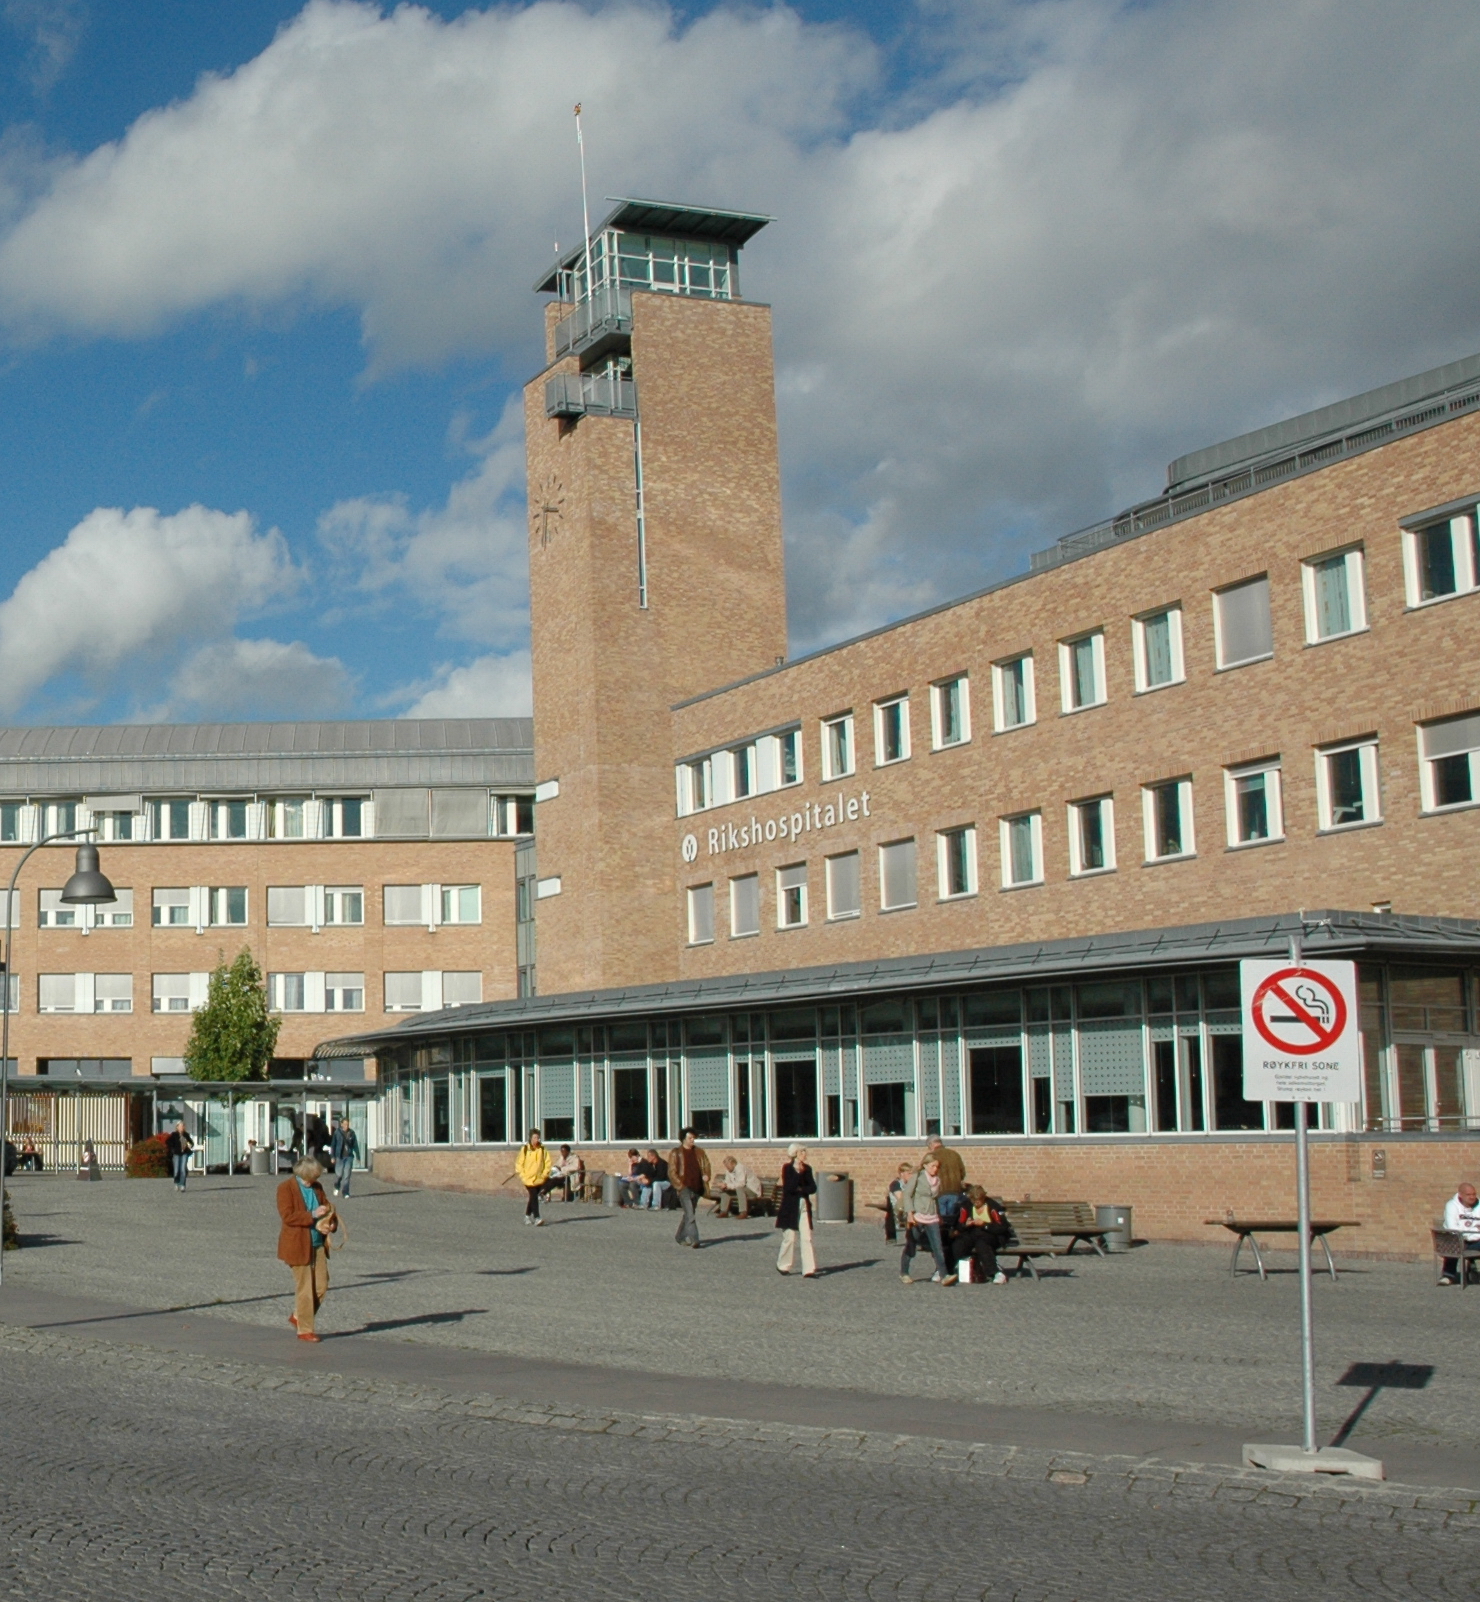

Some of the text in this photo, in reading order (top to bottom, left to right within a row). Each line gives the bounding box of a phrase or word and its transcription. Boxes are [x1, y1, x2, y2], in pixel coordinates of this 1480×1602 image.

[708, 791, 870, 855] Rikshospitalet
[1262, 1060, 1340, 1071] RØYKFRI SONE
